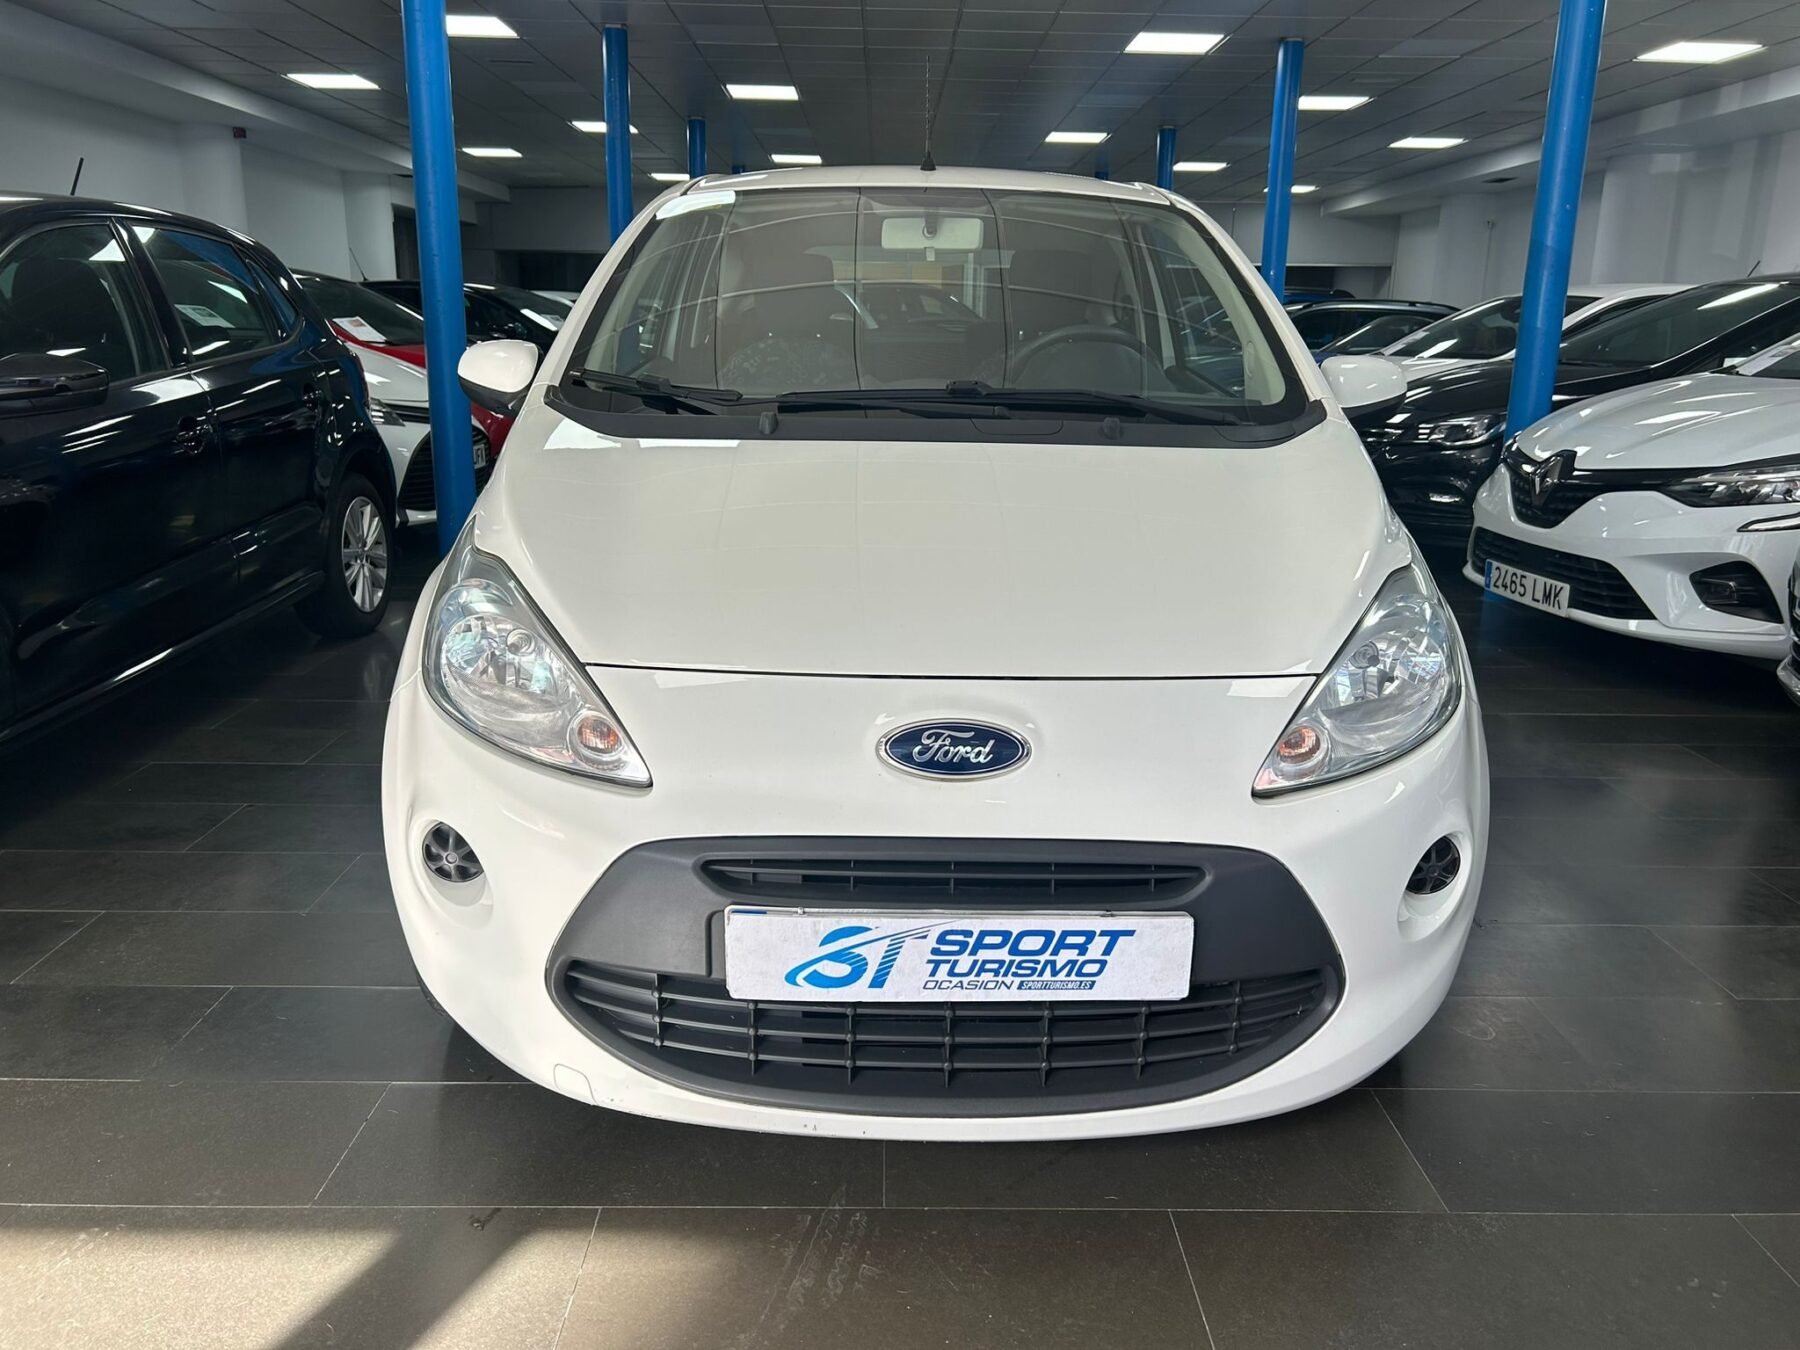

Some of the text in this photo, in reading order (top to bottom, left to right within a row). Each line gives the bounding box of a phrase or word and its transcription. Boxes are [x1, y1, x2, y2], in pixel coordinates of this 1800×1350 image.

[1493, 566, 1564, 610] 2465 LMK
[912, 729, 995, 763] Ford
[930, 929, 1136, 956] SPORT
[925, 959, 1108, 977] TURISMO
[922, 980, 1093, 990] OCASION SPORTTURISMO.ES
